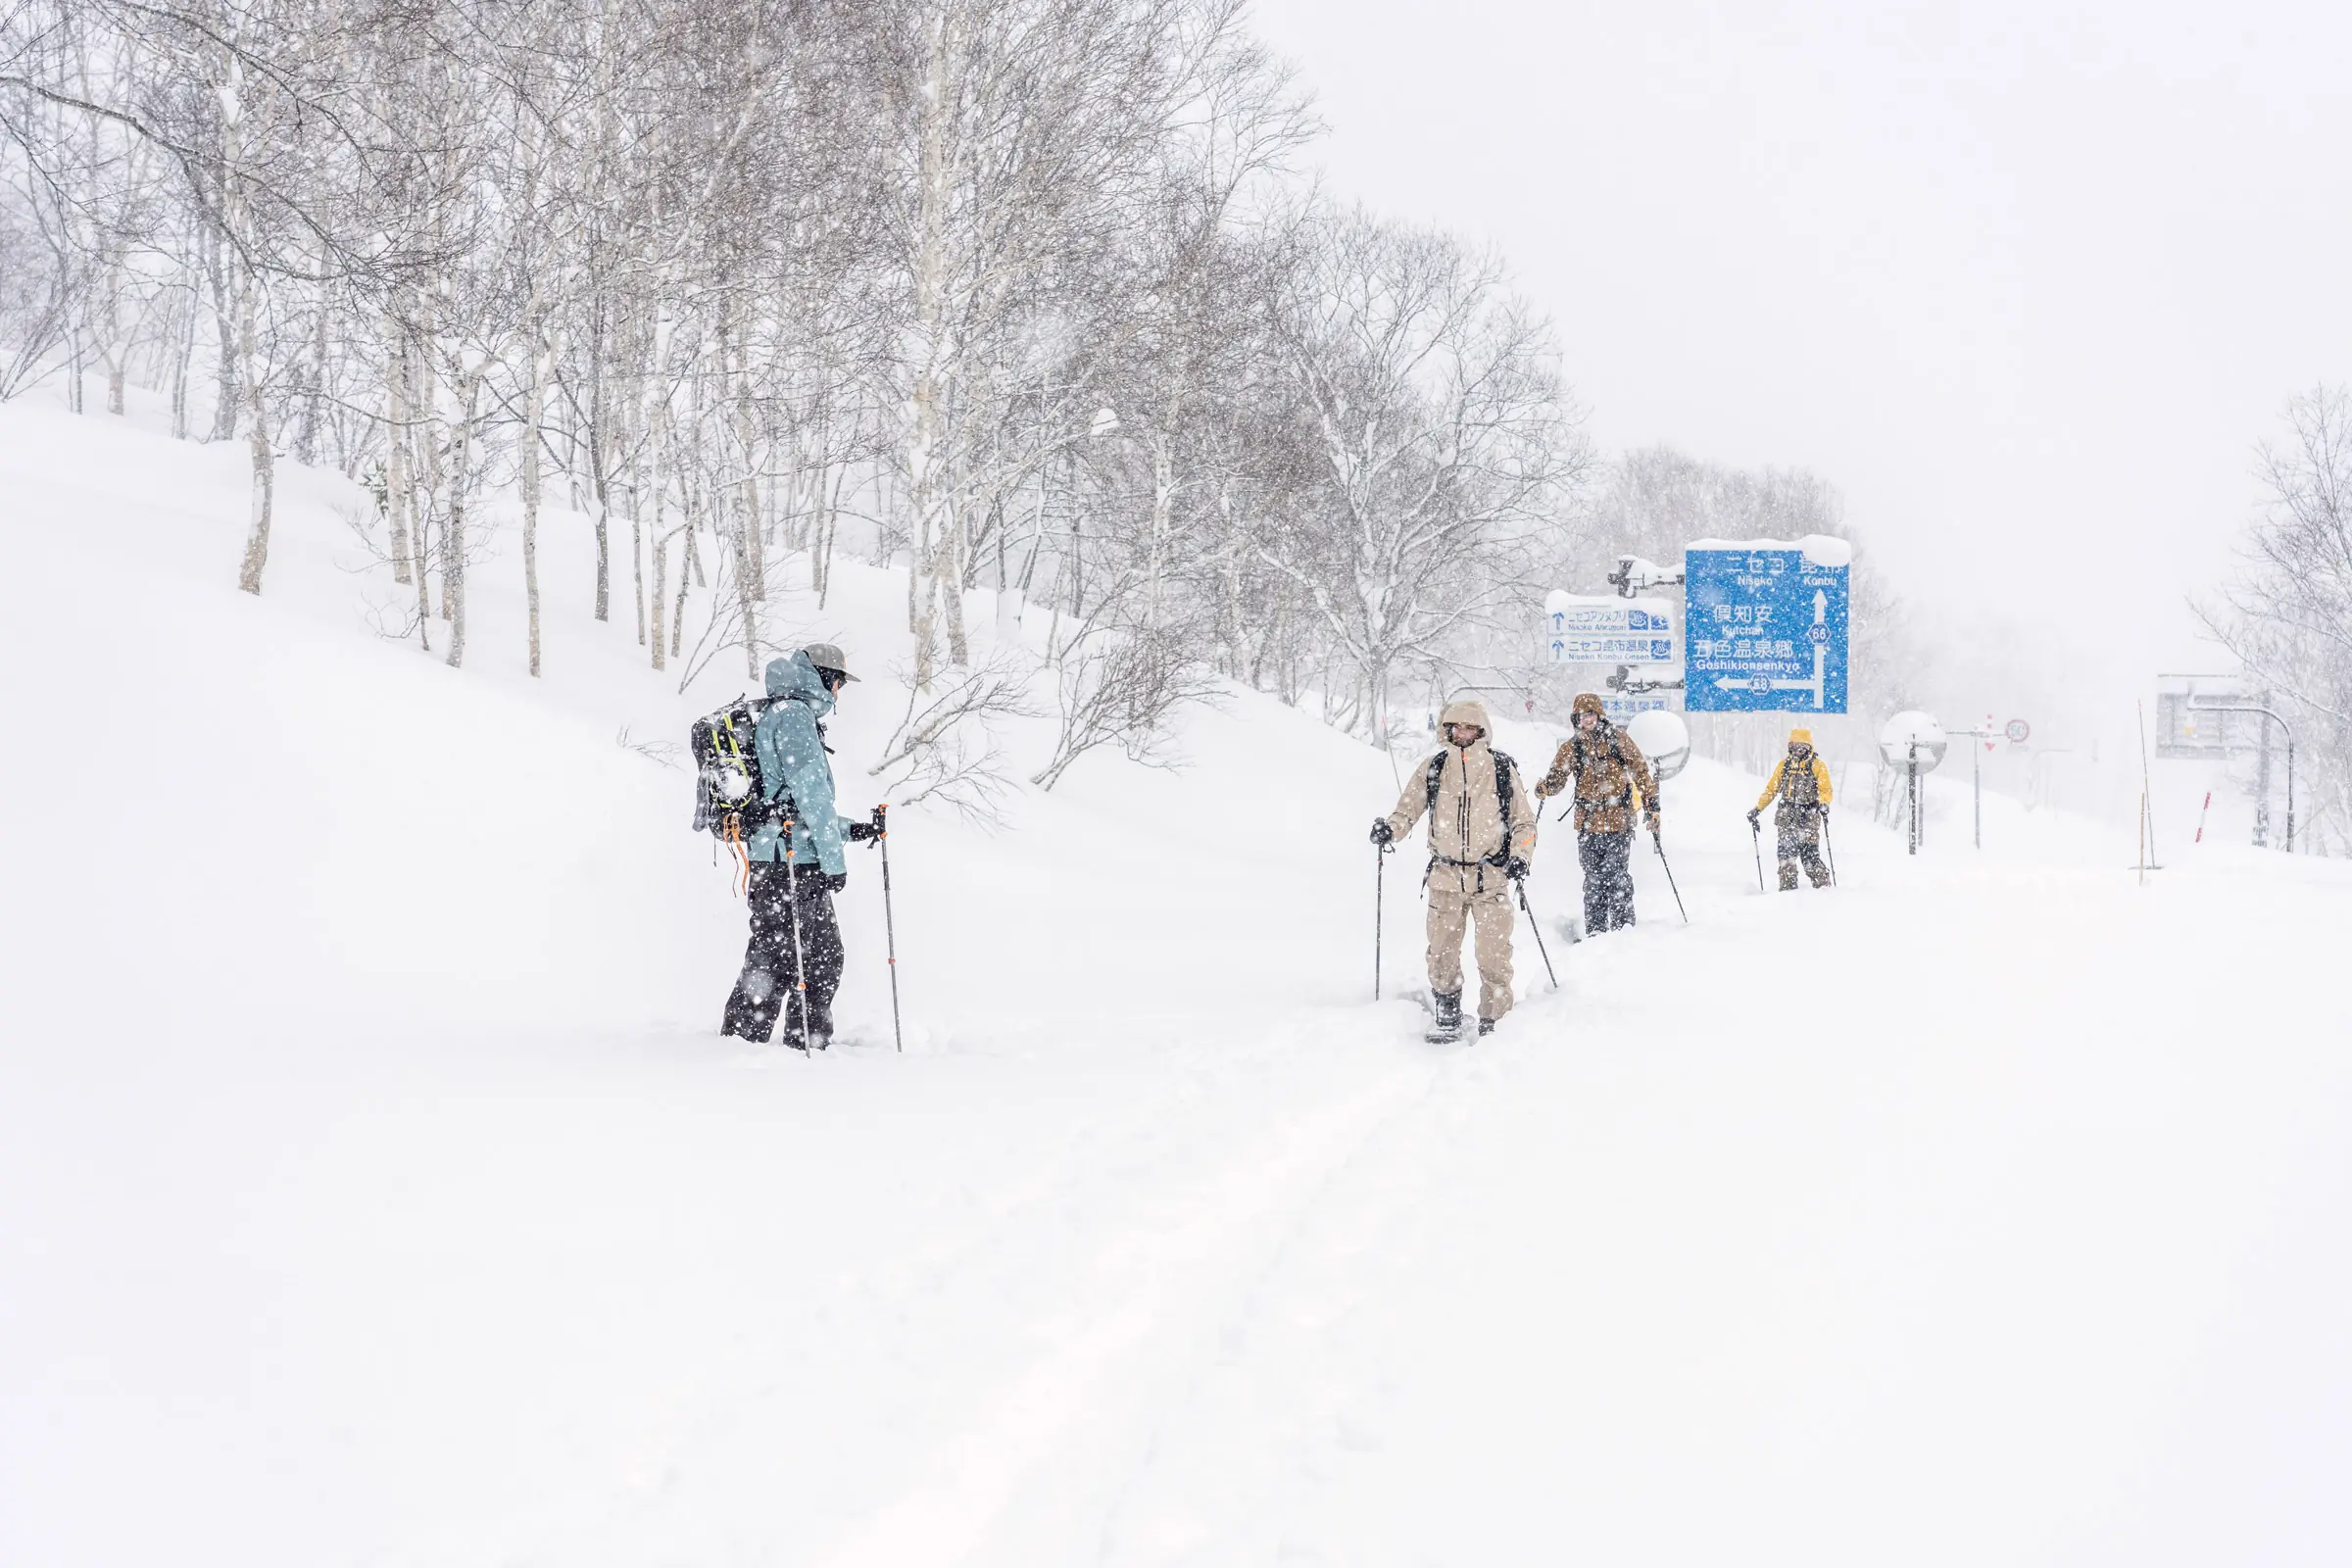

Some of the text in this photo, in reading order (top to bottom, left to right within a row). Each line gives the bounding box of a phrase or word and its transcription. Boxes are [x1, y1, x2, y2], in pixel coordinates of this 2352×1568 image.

[1726, 556, 1785, 573] ニセコ
[1738, 575, 1838, 587] Niseko Konbu
[1722, 625, 1764, 636] Kutchan
[1812, 628, 1827, 640] 66
[1692, 639, 1794, 659] 五色温泉郷
